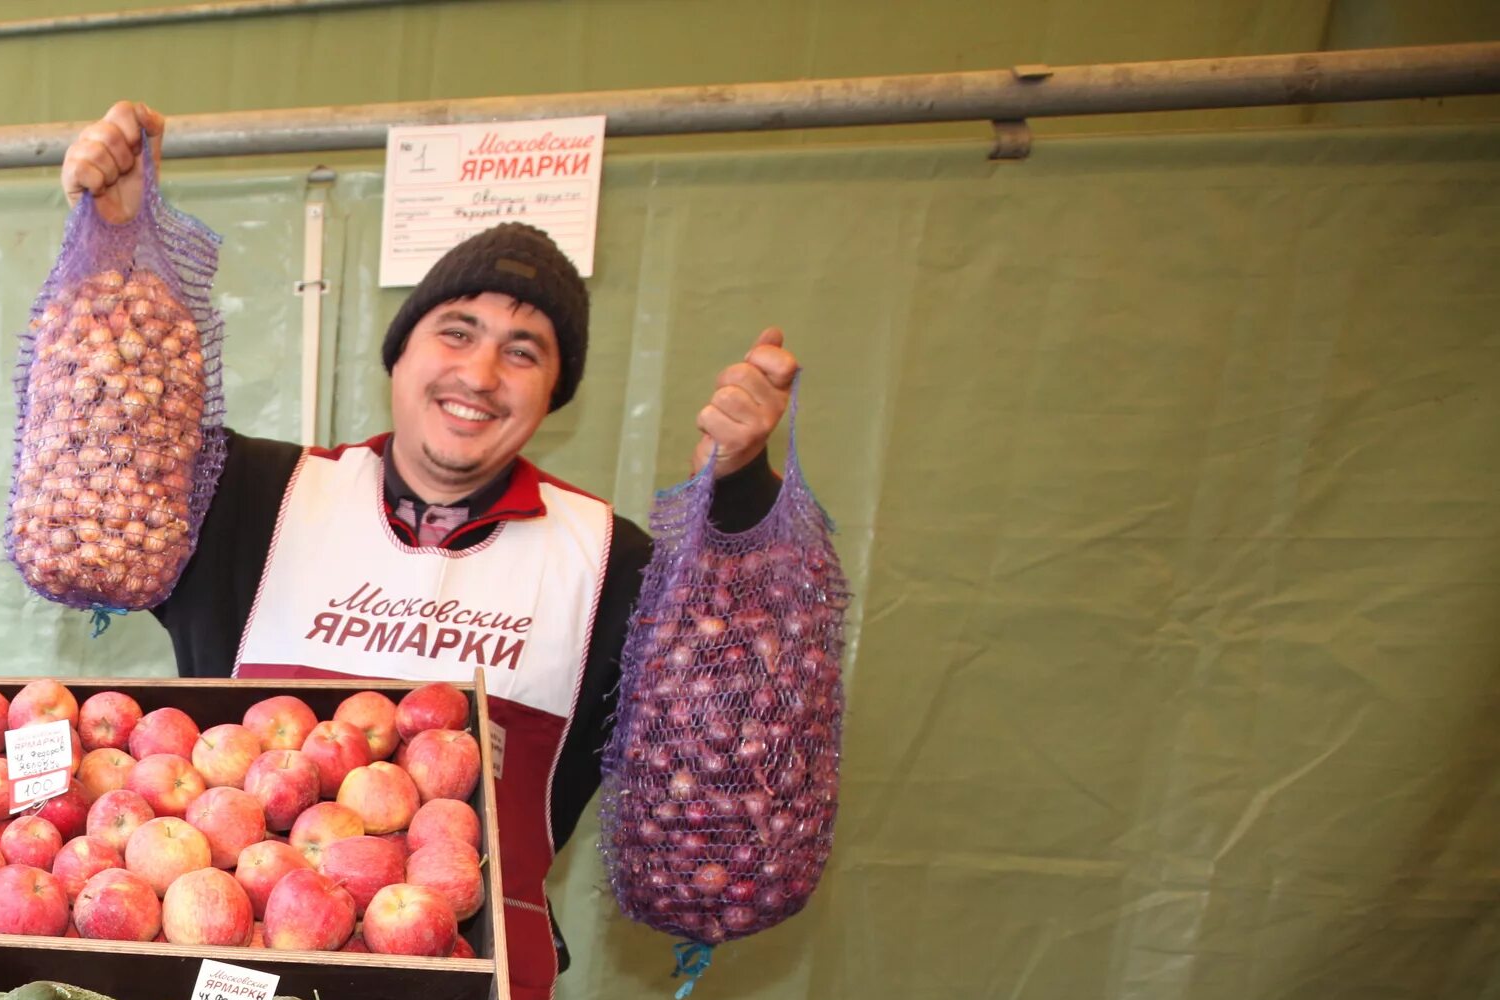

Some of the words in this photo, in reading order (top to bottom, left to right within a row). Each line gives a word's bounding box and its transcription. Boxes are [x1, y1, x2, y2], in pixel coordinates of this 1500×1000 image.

[468, 132, 595, 155] Московские
[459, 153, 591, 181] ЯРМАРКИ
[329, 581, 534, 634] Московские
[304, 611, 527, 671] ЯРМАРКИ
[24, 778, 54, 797] 100
[204, 979, 268, 1000] ЯРМАРКИ
